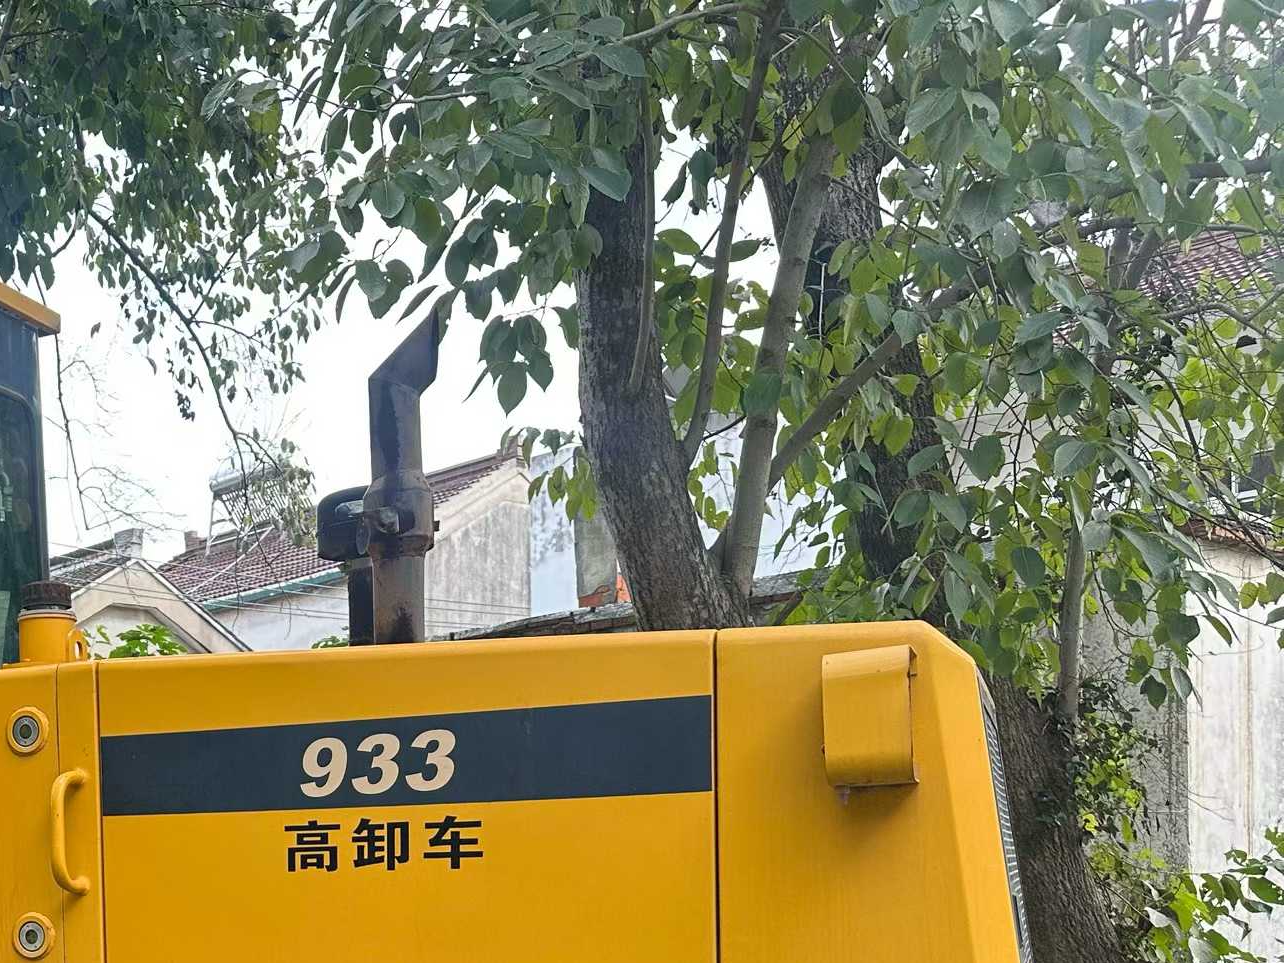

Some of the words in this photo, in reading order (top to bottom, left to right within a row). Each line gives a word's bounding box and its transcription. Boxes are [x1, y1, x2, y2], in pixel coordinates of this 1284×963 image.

[300, 729, 456, 797] 933
[284, 815, 484, 872] 高卸车
